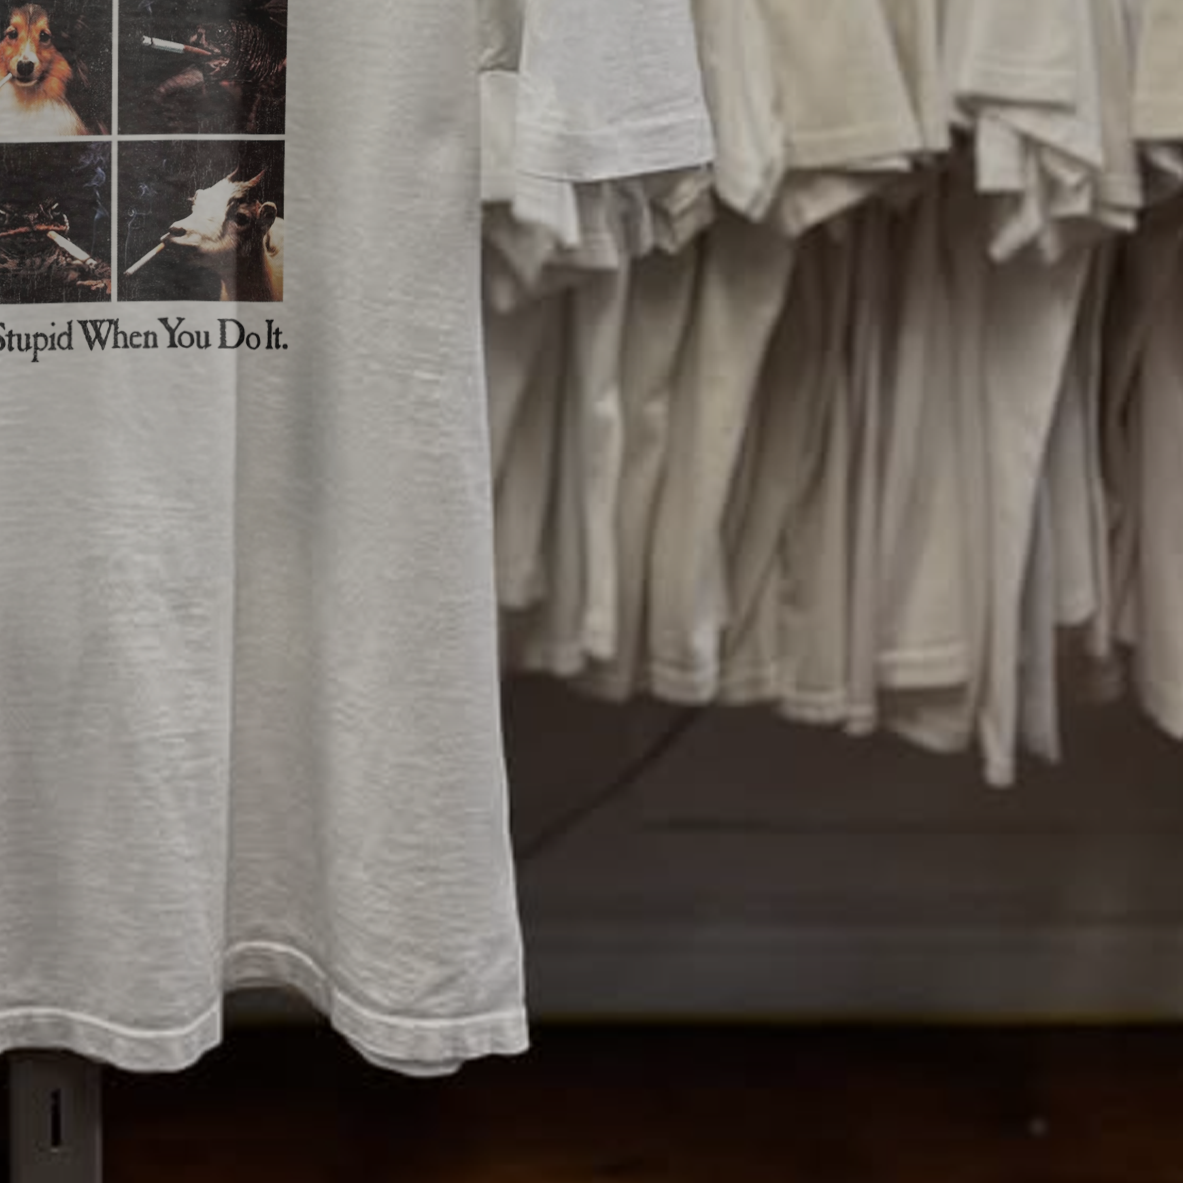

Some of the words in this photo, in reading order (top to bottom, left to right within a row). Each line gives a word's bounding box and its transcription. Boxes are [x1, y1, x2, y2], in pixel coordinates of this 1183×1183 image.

[76, 317, 157, 351] When
[157, 315, 213, 350] You
[216, 317, 261, 351] Do
[264, 317, 290, 351] It.
